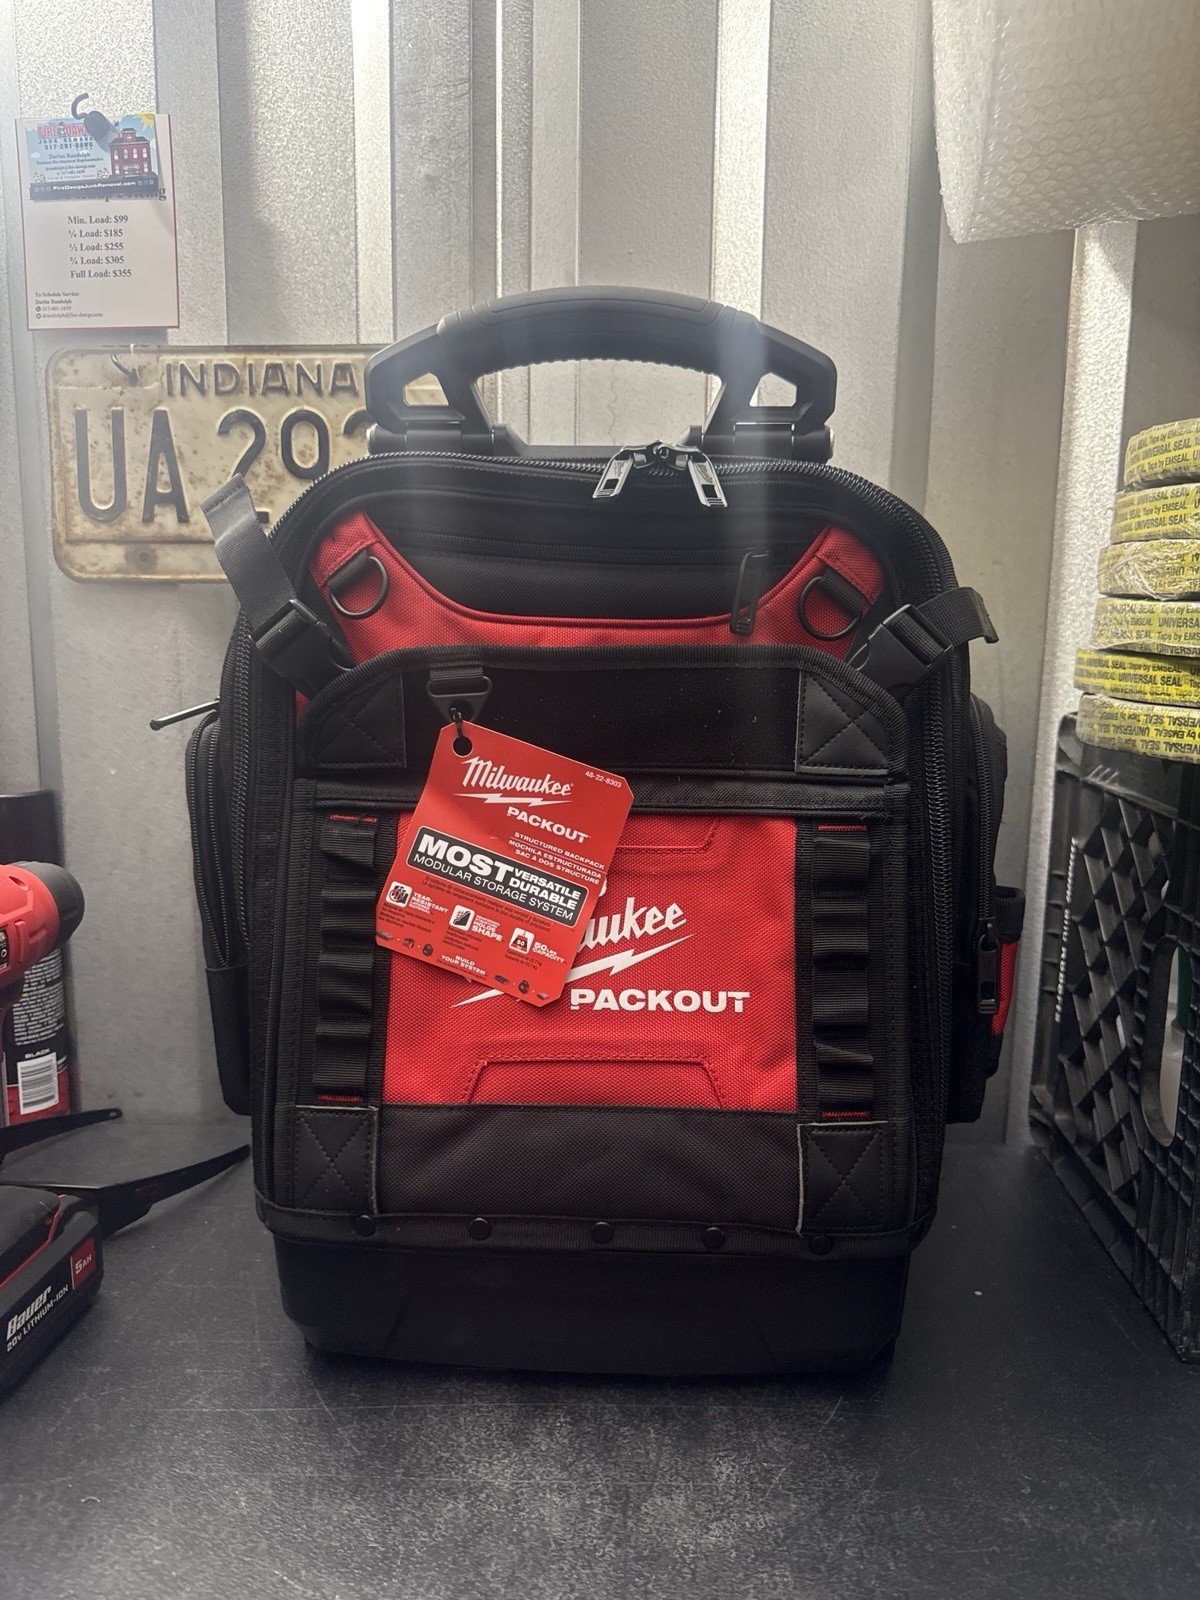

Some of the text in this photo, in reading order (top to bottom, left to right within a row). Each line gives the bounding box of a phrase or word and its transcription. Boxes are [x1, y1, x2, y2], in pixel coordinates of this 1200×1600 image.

[67, 215, 128, 224] Min. Load: $99
[79, 229, 102, 238] Load:
[103, 228, 123, 237] $185
[80, 243, 103, 251] Load:
[104, 243, 124, 251] $255
[80, 257, 103, 265] Load:
[105, 256, 125, 264] $305
[70, 269, 132, 279] Full Load: $355
[166, 362, 360, 397] INDIANA
[1173, 438, 1191, 451] SEAL
[75, 407, 368, 524] UA 20
[1165, 452, 1189, 466] EMSEAL
[1170, 487, 1190, 498] SEAL
[1161, 501, 1187, 513] EMSEAL
[1134, 514, 1187, 531] UNIVERSAL SEAL
[1175, 605, 1185, 615] by
[1186, 606, 1200, 614] EMS
[1158, 617, 1200, 628] UNIVERSA
[1157, 632, 1172, 641] Tape
[1173, 632, 1183, 642] by
[1184, 632, 1200, 641] EMS
[1118, 673, 1158, 688] UNIVERSAL
[1160, 675, 1183, 687] SEAL
[1189, 679, 1200, 690] Tap
[1144, 713, 1164, 725] SEAL
[1168, 715, 1200, 728] VERSAL
[1113, 724, 1150, 737] UNIVERSAL
[1154, 728, 1185, 739] EMSEAL
[1186, 730, 1196, 740] by
[1141, 740, 1160, 750] SEAL
[460, 756, 572, 796] Milwaukee
[585, 770, 622, 788] 48-22-8303
[506, 806, 589, 844] PACKOUT
[514, 832, 605, 870] STRUCTURED BACKPACK
[418, 834, 514, 883] MOST
[509, 839, 602, 878] MOCHILA ESTRUCTURADA
[515, 849, 531, 859] SAC
[538, 857, 554, 868] DOS
[413, 854, 574, 921] MODULAR STORAGE SYSTEM
[514, 869, 581, 900] VERSATILE
[412, 891, 433, 902] TEAR-
[509, 878, 578, 911] DURABLE
[410, 896, 449, 913] RESISTANT
[470, 924, 503, 941] SHAPE
[472, 920, 496, 932] HOLDS
[533, 941, 548, 951] 50
[454, 955, 475, 965] BUILD
[531, 947, 565, 963] CAPACITY
[440, 954, 459, 964] YOUR
[459, 962, 486, 975] SYSTEM
[570, 988, 750, 1013] PACKOUT
[24, 1049, 50, 1059] BLACK
[6, 1285, 52, 1341] Bauer
[23, 1284, 69, 1335] LITHIUM-ION
